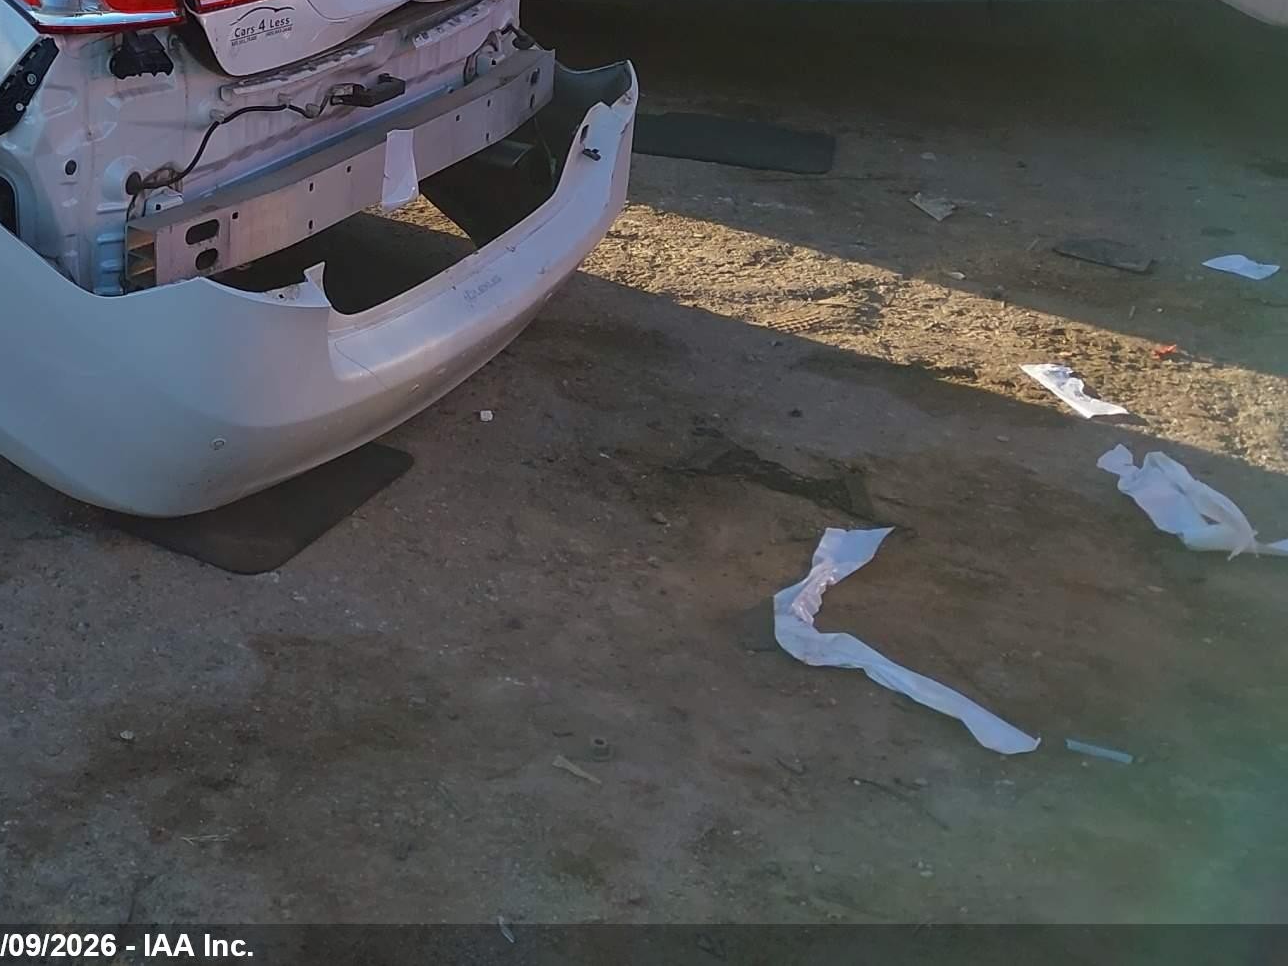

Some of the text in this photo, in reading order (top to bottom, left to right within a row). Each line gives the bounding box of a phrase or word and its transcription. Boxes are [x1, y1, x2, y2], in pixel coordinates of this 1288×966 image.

[234, 26, 255, 38] Cars
[258, 19, 265, 31] 4
[269, 17, 290, 28] Less
